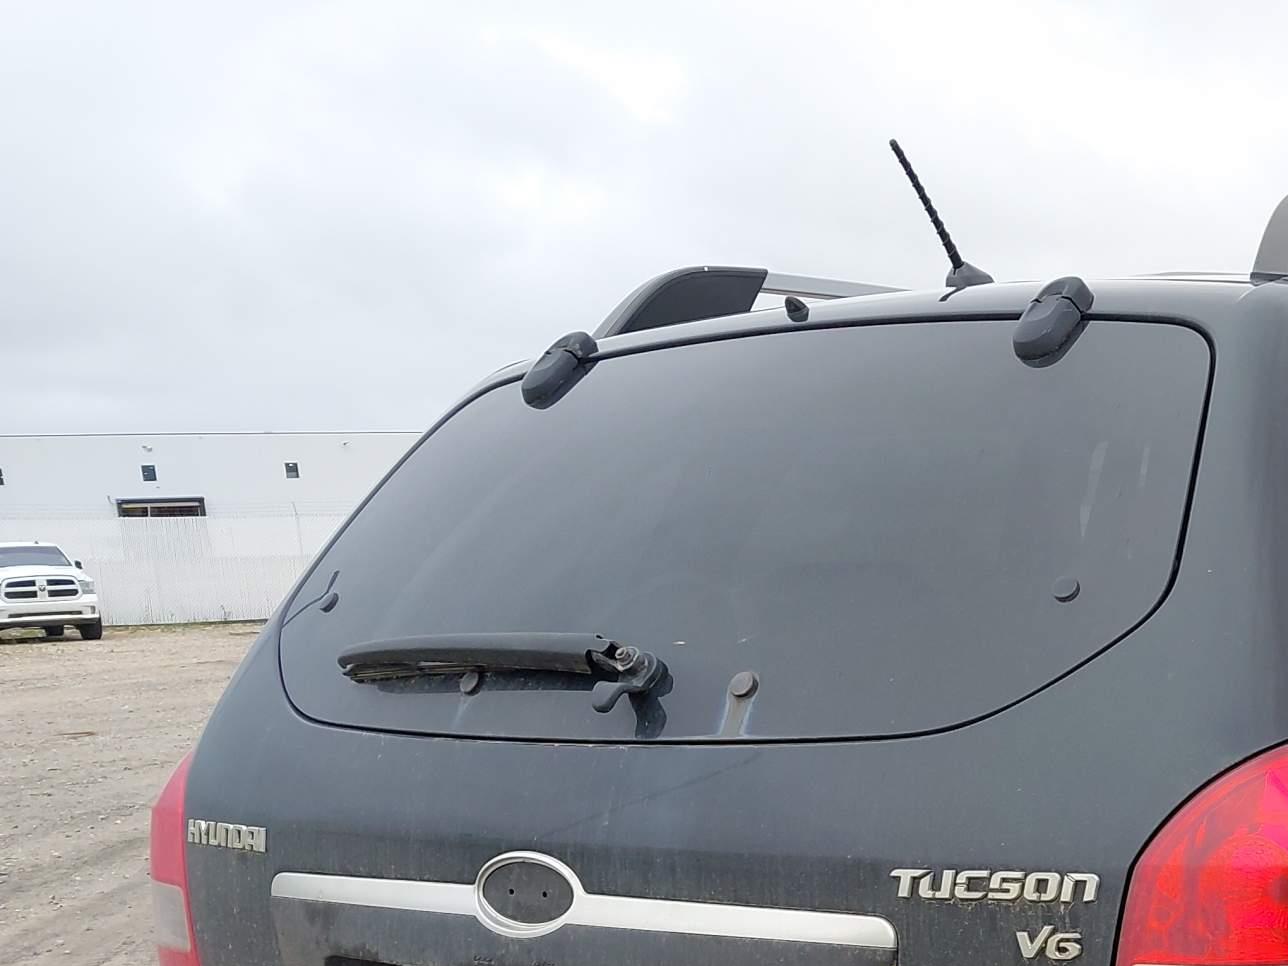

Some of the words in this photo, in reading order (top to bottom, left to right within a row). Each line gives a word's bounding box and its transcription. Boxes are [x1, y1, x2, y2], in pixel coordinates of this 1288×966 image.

[187, 818, 267, 853] HYUNDAI
[890, 868, 1100, 902] TUCSON
[1016, 925, 1083, 960] V6
